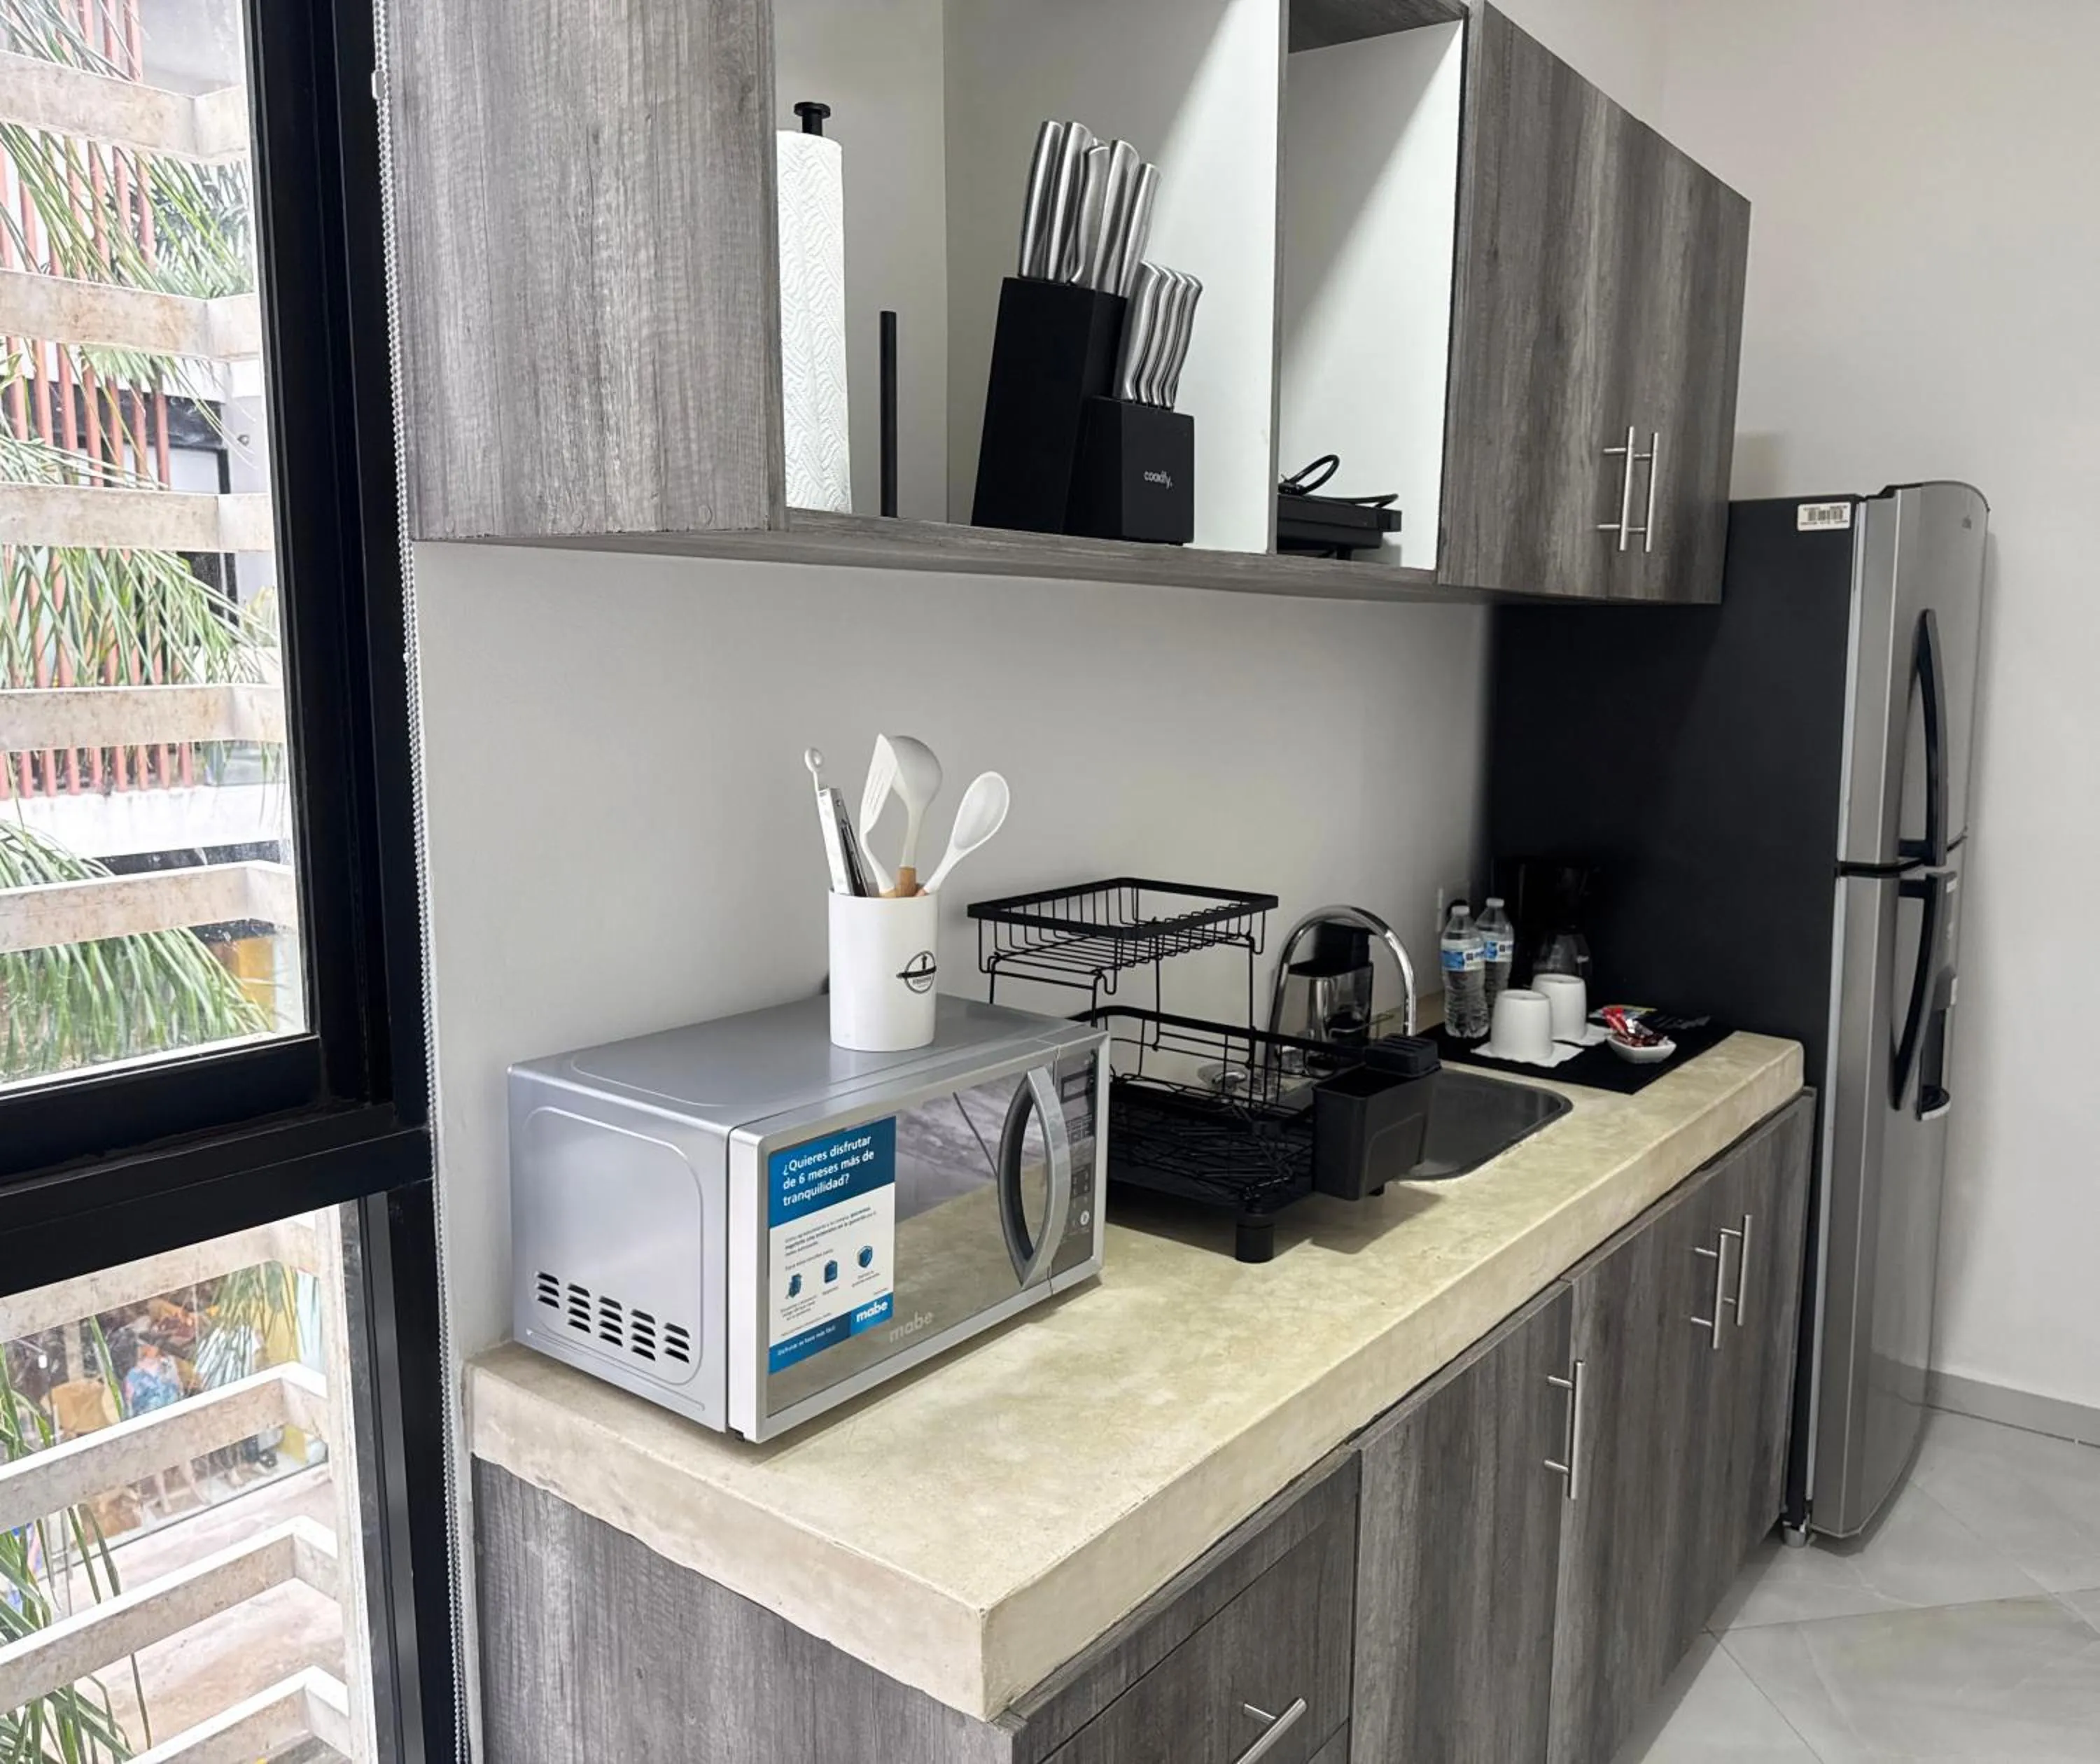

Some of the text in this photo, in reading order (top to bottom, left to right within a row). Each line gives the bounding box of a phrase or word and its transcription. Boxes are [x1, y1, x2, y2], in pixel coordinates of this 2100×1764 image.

[783, 1135, 872, 1176] ¿Quieres disfrutar
[783, 1150, 874, 1189] de 6 meses más de
[783, 1172, 850, 1207] tranquilidad?
[856, 1301, 888, 1322] mabe
[890, 1310, 934, 1343] mabe
